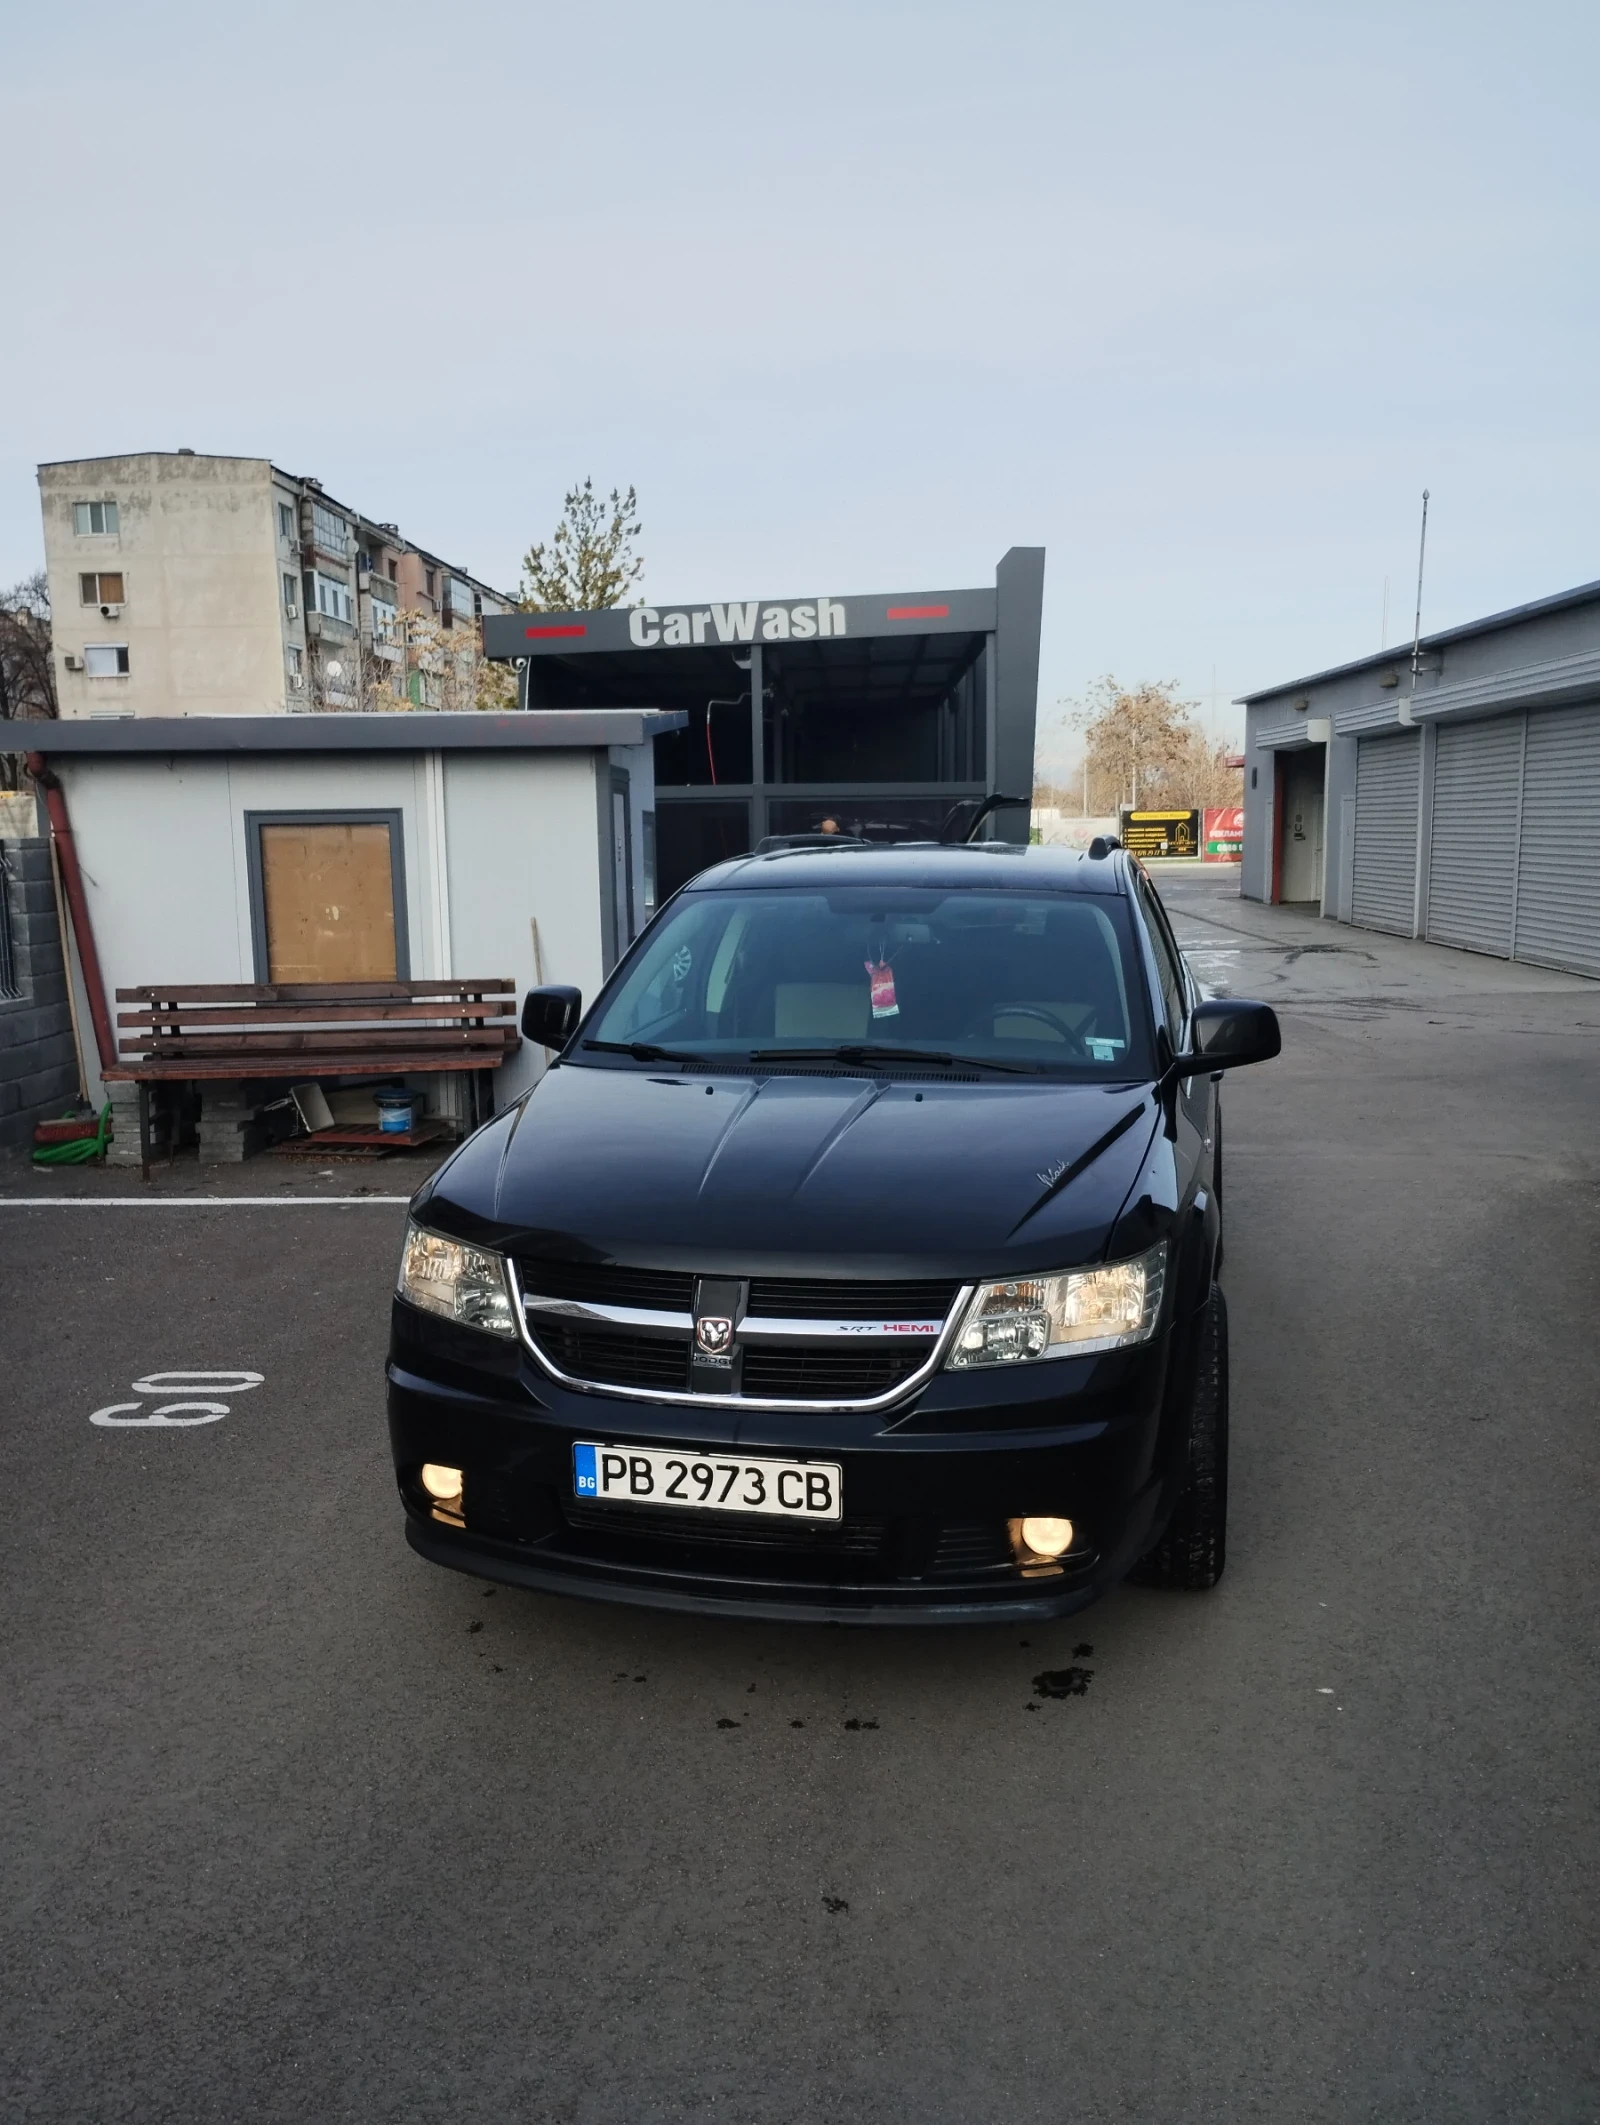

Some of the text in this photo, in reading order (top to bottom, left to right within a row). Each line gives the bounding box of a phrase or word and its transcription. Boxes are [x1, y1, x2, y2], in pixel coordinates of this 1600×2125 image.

[629, 598, 846, 647] CarWash
[883, 1324, 934, 1332] HEMI
[578, 1475, 596, 1489] BG
[602, 1453, 832, 1512] PB 2973 CB
